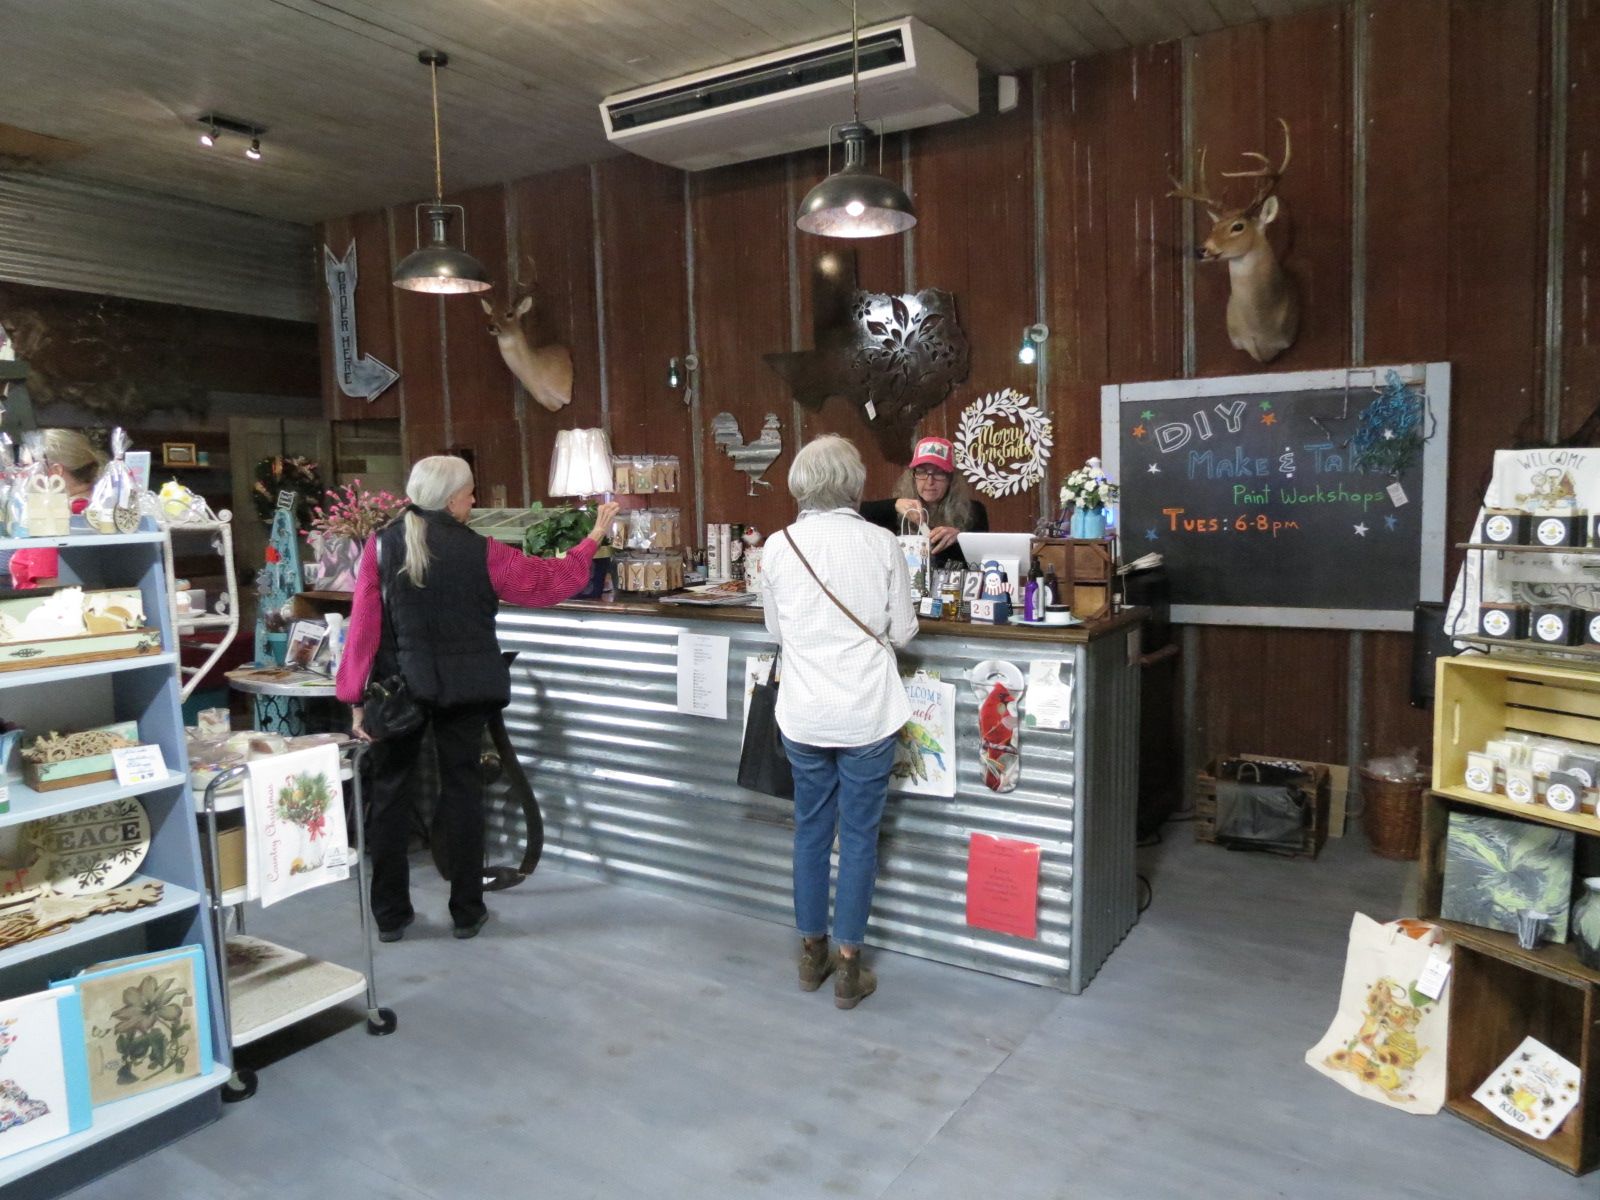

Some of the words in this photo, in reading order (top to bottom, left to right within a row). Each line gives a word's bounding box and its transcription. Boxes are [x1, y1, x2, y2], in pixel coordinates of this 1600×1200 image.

[337, 271, 349, 332] ORDER
[341, 335, 352, 385] HERE
[978, 425, 1026, 449] Merry
[1155, 400, 1247, 453] DIY
[969, 441, 1035, 467] Christmas
[1516, 451, 1588, 470] WELCOME
[1233, 483, 1271, 505] Paint
[1280, 482, 1386, 513] Workshops
[905, 685, 943, 706] ELCOME
[264, 783, 276, 837] Christmas
[43, 821, 142, 852] EACE
[266, 839, 281, 882] Country
[1498, 1100, 1527, 1123] KIND
